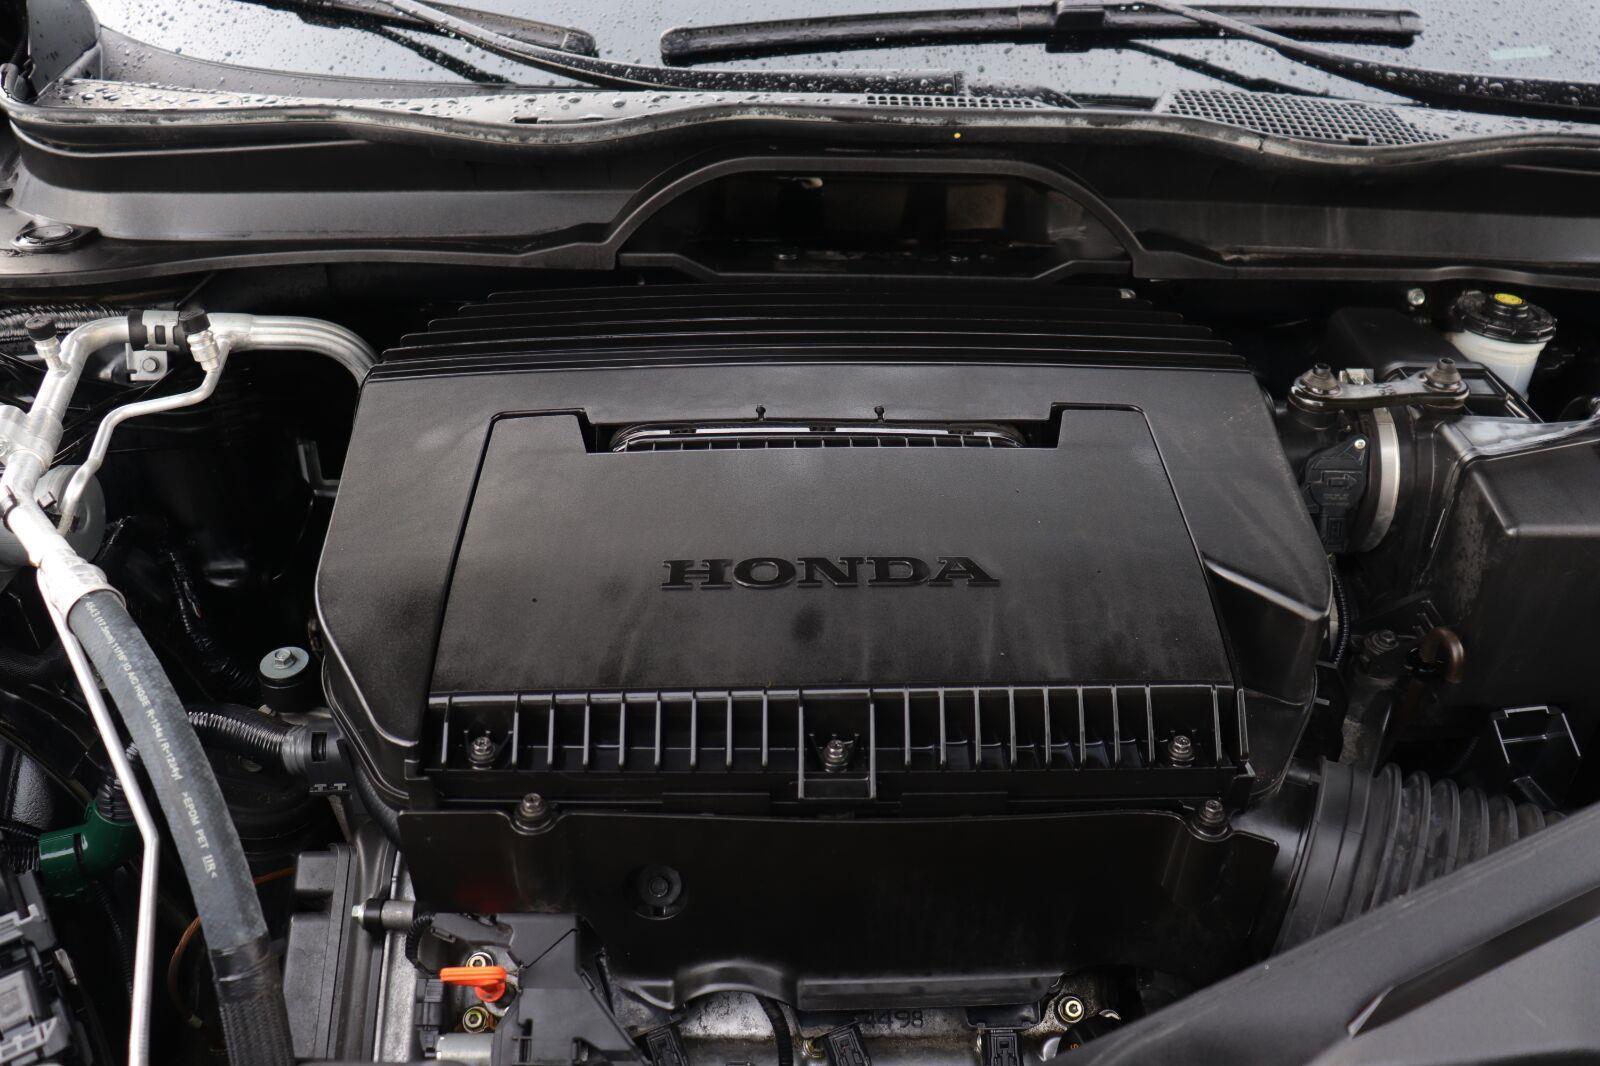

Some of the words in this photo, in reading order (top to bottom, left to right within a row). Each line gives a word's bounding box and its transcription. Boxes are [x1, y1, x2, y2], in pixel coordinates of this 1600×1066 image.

[661, 556, 1000, 588] HONDA
[134, 682, 151, 707] HOSE
[195, 829, 210, 849] PET
